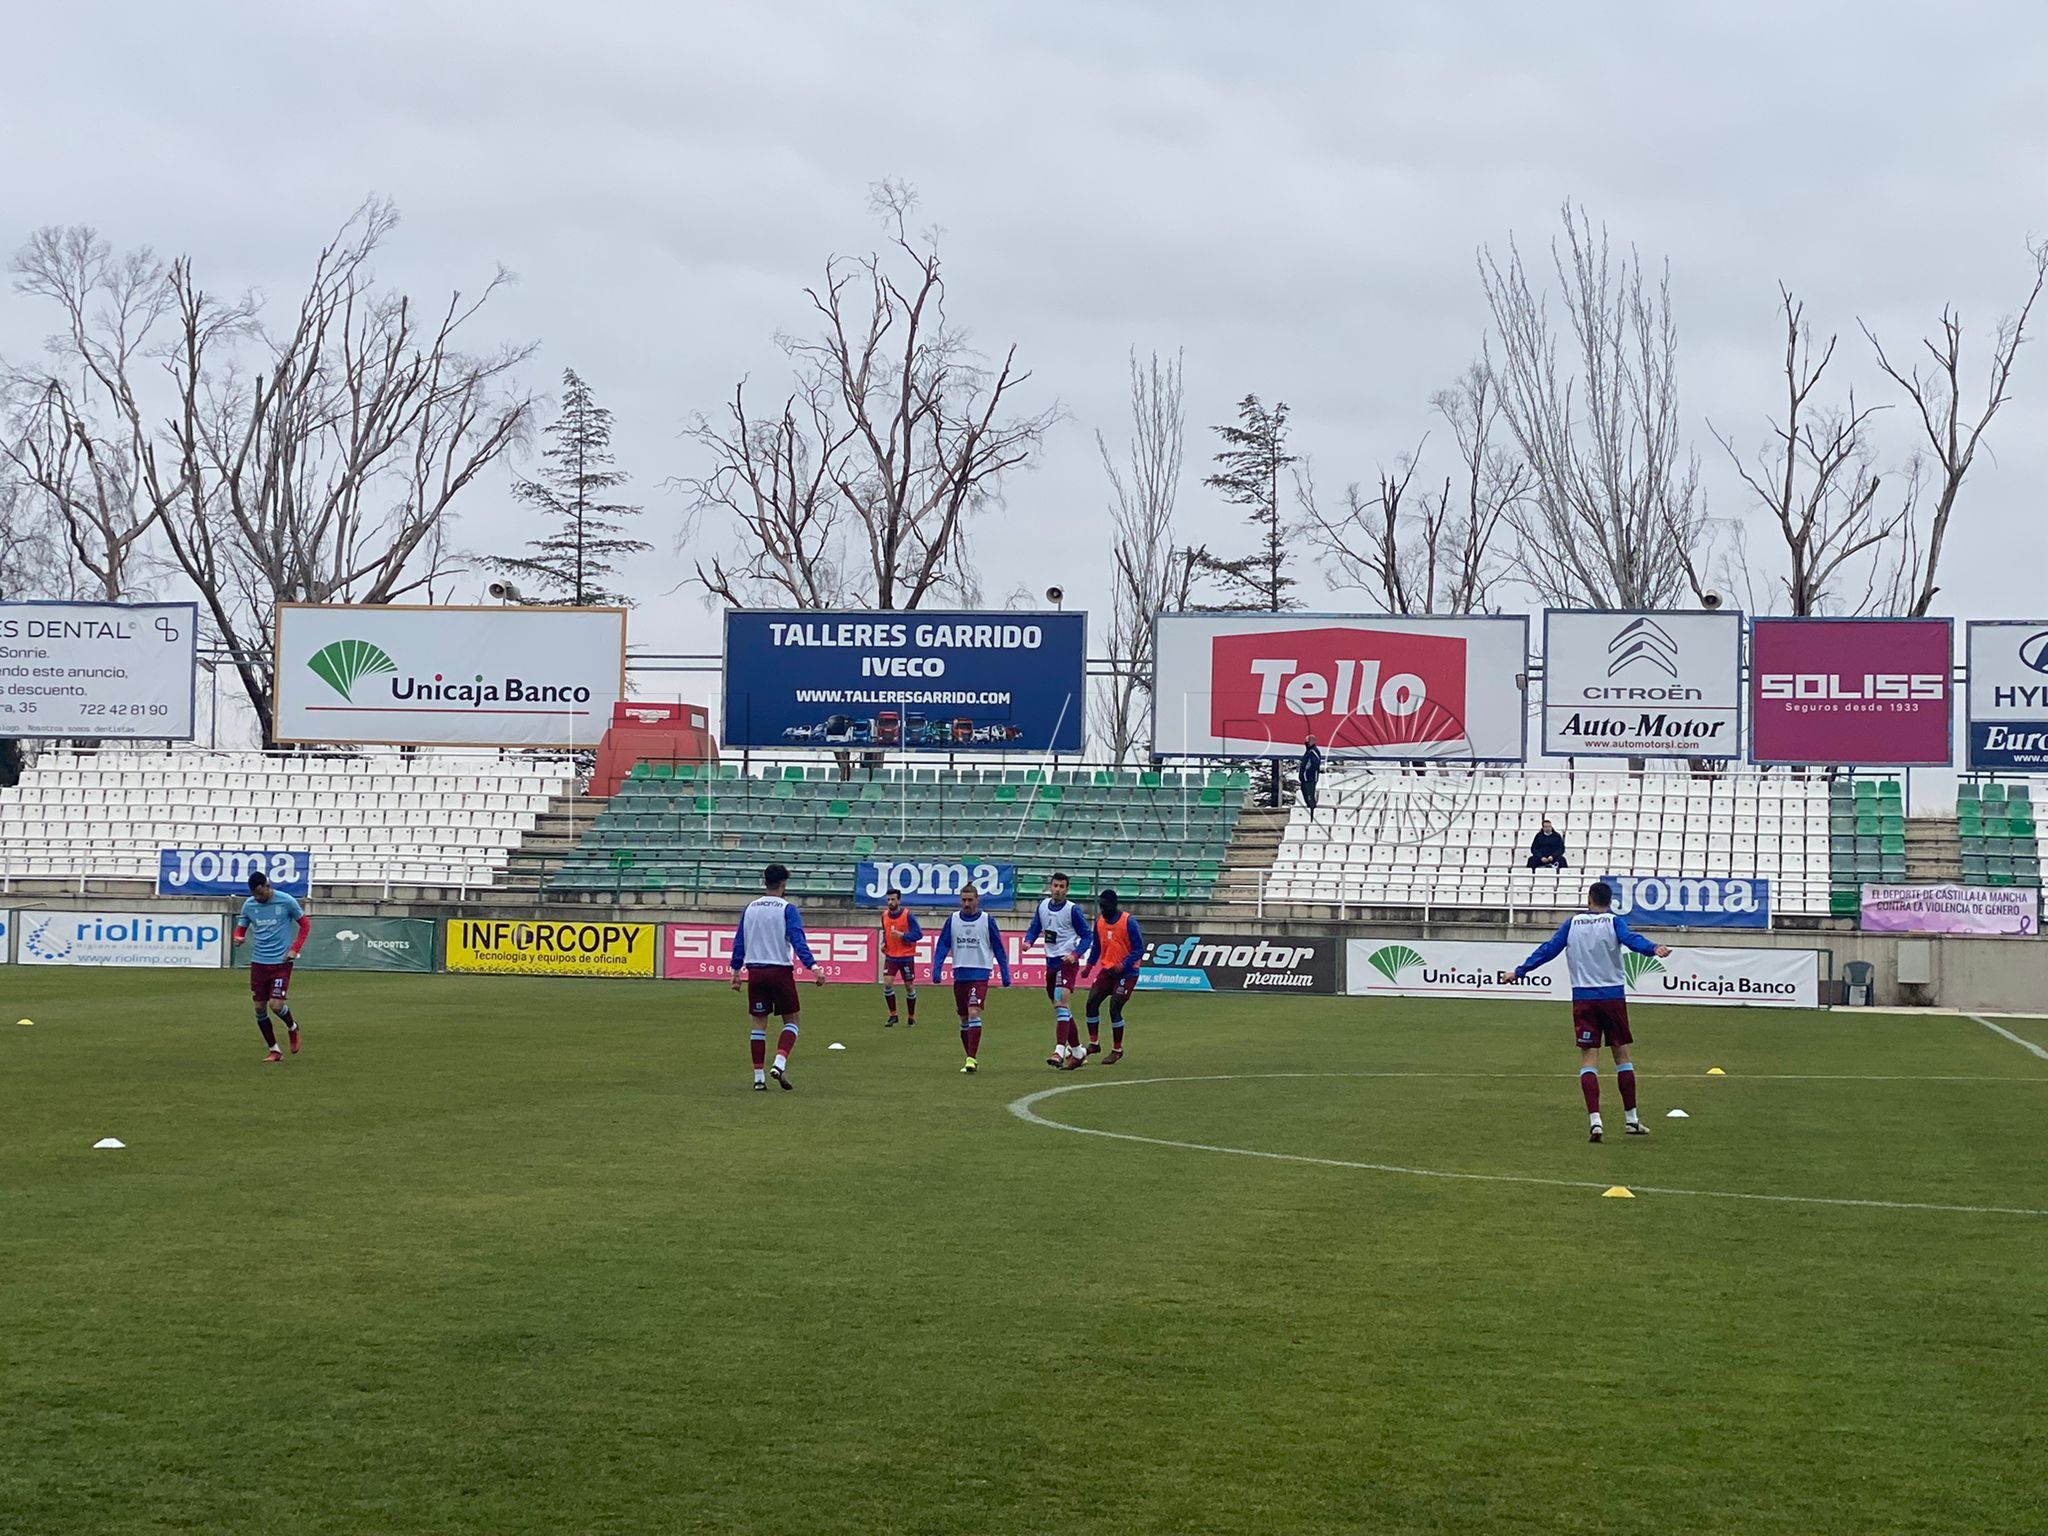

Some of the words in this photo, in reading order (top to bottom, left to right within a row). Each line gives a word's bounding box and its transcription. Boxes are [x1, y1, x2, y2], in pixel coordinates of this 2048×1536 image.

[769, 623, 907, 648] TALLERES
[915, 624, 1043, 649] GARRIDO
[0, 665, 29, 677] ndo
[33, 667, 64, 678] este
[68, 667, 129, 680] anuncio,
[861, 656, 946, 678] IVECO
[8, 682, 88, 696] descuento.
[391, 673, 499, 708] Unicaja
[505, 678, 590, 703] Banco
[1250, 658, 1427, 716] Tello
[1761, 674, 1944, 700] SOLISS
[19, 701, 37, 713] 35
[796, 690, 1011, 705] WWW.TALLERESGARRIDO.COM
[1785, 702, 1839, 713] Seguros
[1845, 702, 1883, 712] desde
[1890, 702, 1919, 712] 1933
[80, 703, 106, 716] 722
[109, 704, 127, 716] 42
[130, 704, 145, 716] 81
[149, 704, 168, 716] 90
[1559, 712, 1725, 738] Auto-Motor
[1872, 889, 1880, 900] EL
[1883, 889, 1920, 900] DEPORTE
[1923, 889, 1934, 900] DE
[1989, 891, 2028, 903] MANCHA
[1877, 901, 1911, 911] CONTRA
[1913, 902, 1924, 912] LA
[1926, 902, 1971, 913] VIOLENCIA
[1973, 903, 1983, 915] DE
[77, 918, 219, 951] riolimp
[463, 922, 640, 954] INFORCOPY
[367, 940, 410, 950] DEPORTES
[529, 954, 535, 965] y
[537, 954, 577, 965] equipos
[578, 955, 592, 963] de
[593, 955, 628, 964] oficina
[1243, 969, 1314, 989] premium
[1423, 967, 1494, 988] Unicaja
[1663, 973, 1735, 996] Unicaja
[1738, 978, 1796, 994] Banco
